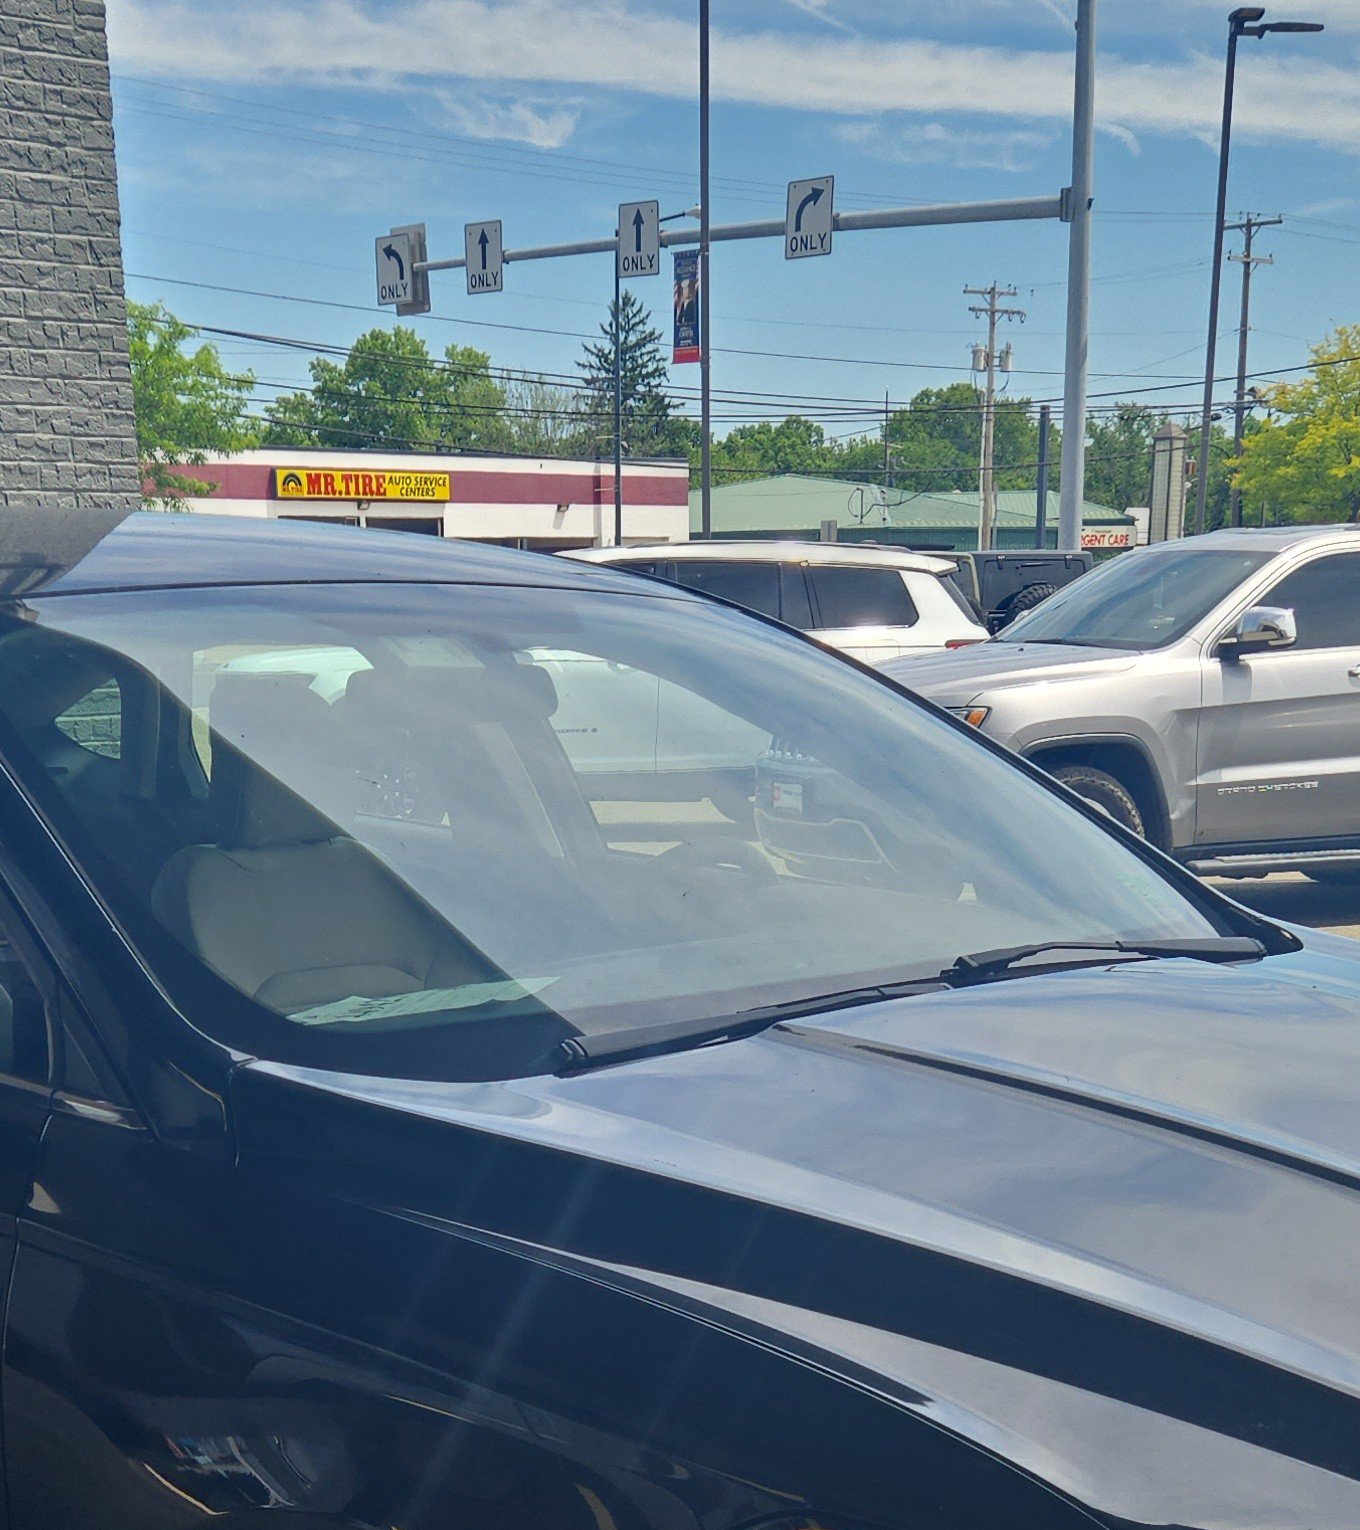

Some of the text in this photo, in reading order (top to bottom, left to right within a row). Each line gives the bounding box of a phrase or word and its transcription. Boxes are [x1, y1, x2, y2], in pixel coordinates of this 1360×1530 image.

[790, 233, 827, 252] ONLY
[622, 253, 655, 271] ONLY
[470, 271, 498, 289] ONLY
[380, 283, 408, 299] ONLY
[387, 475, 447, 487] AUTO SERVICE
[399, 486, 436, 497] CENTERS
[1107, 534, 1130, 546] CARE
